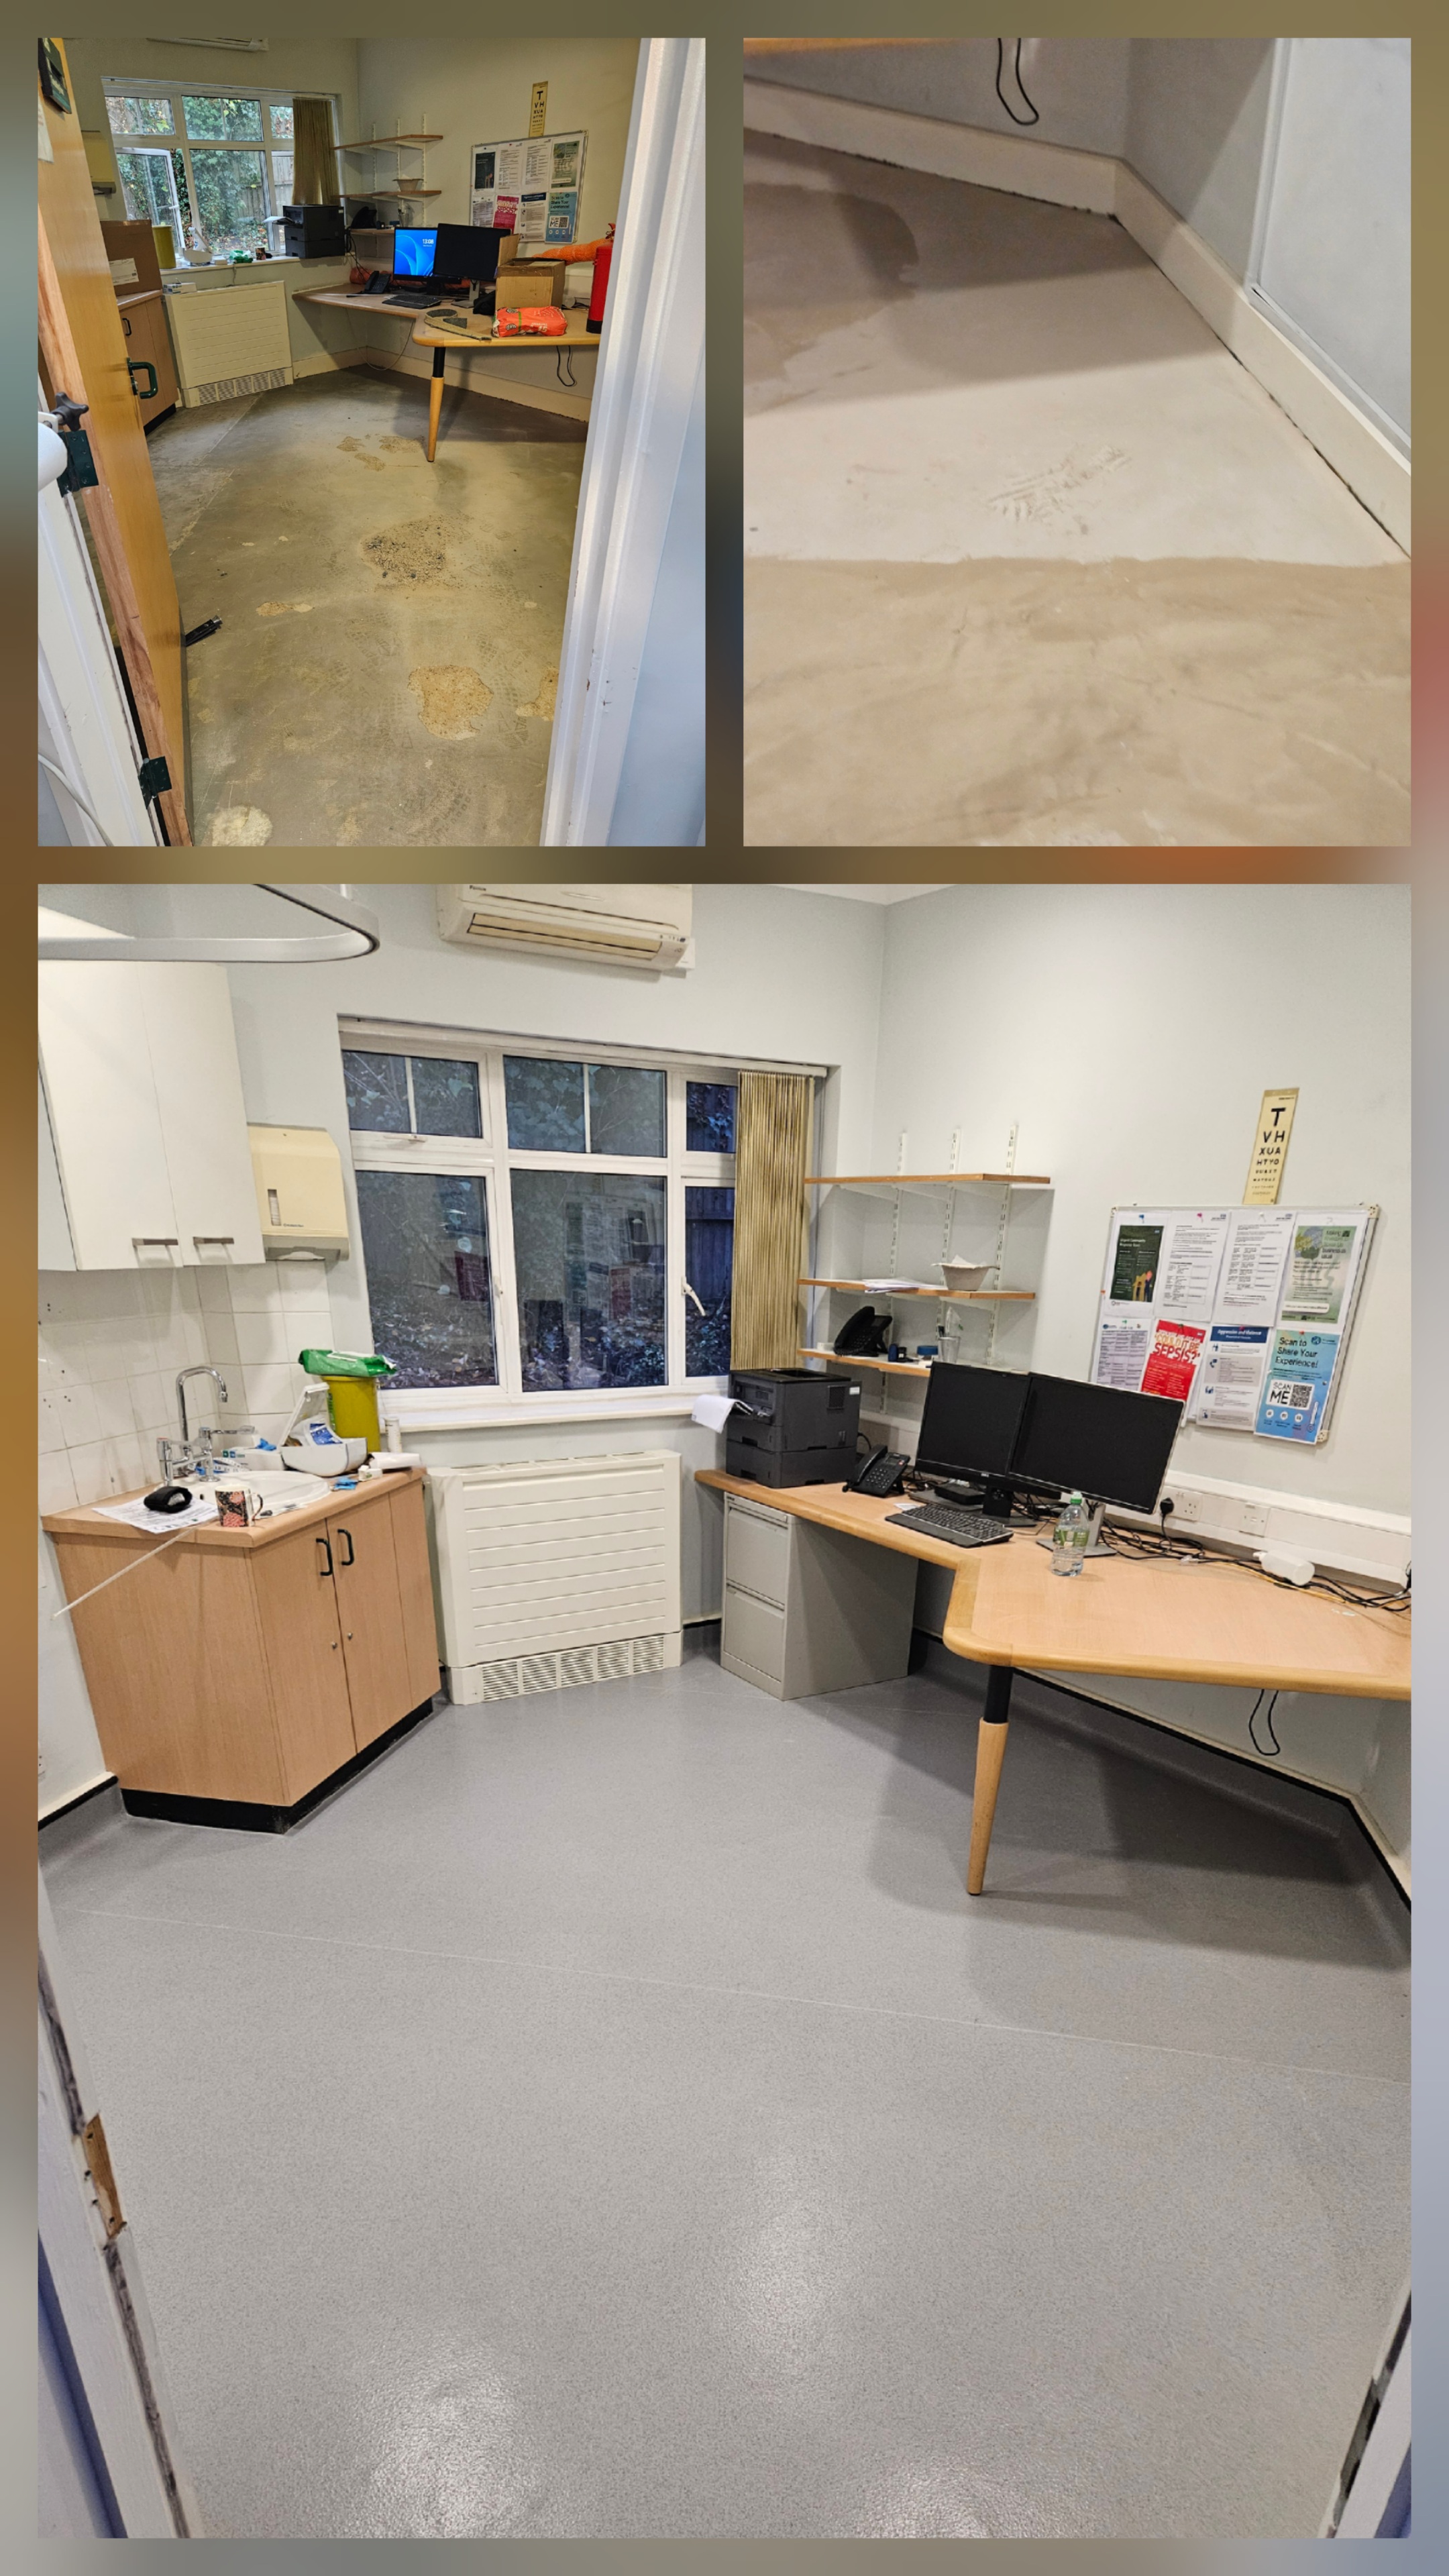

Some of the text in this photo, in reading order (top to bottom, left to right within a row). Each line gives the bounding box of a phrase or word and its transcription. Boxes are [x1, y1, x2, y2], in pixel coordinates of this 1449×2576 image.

[537, 91, 543, 100] T
[1271, 1108, 1286, 1127] T
[1258, 1146, 1281, 1156] XUA
[1279, 1337, 1307, 1346] Scan to
[1277, 1346, 1318, 1358] Share Your
[1275, 1356, 1319, 1368] Experience!
[1273, 1382, 1292, 1391] SCAN
[1269, 1390, 1291, 1405] ME
